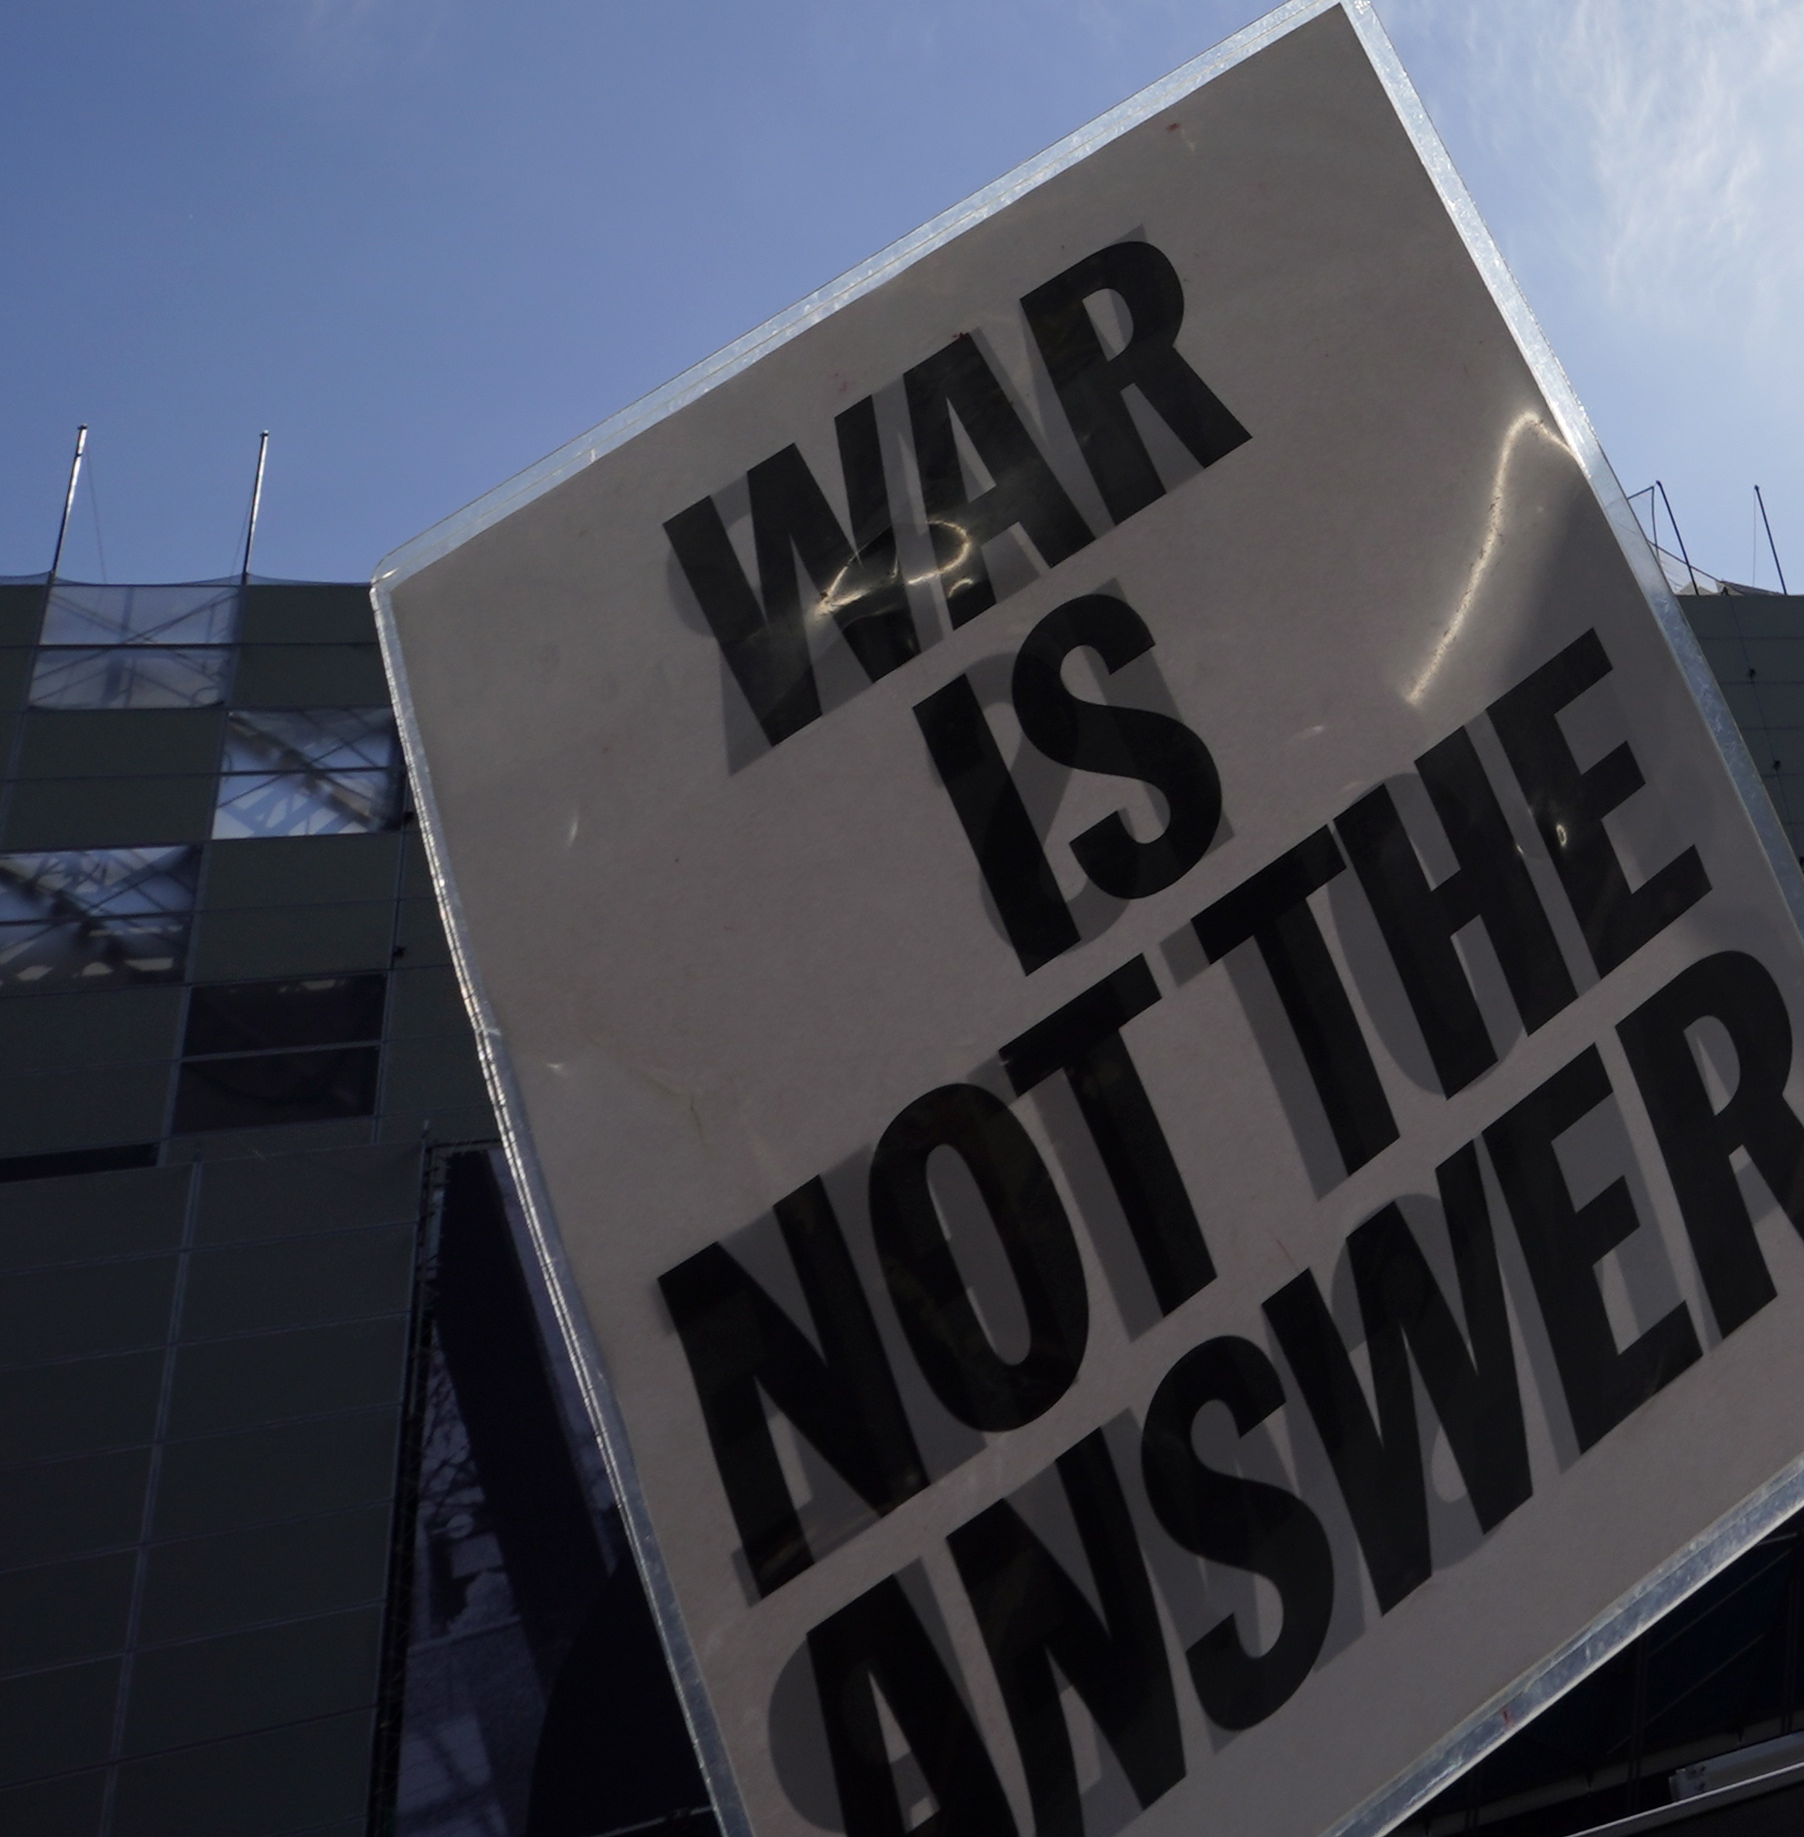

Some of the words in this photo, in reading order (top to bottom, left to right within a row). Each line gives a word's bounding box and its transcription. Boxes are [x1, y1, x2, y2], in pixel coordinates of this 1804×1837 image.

[663, 239, 1252, 746] WAR
[912, 592, 1223, 976] IS
[658, 956, 1216, 1601] NOT
[1190, 628, 1712, 1176] THE
